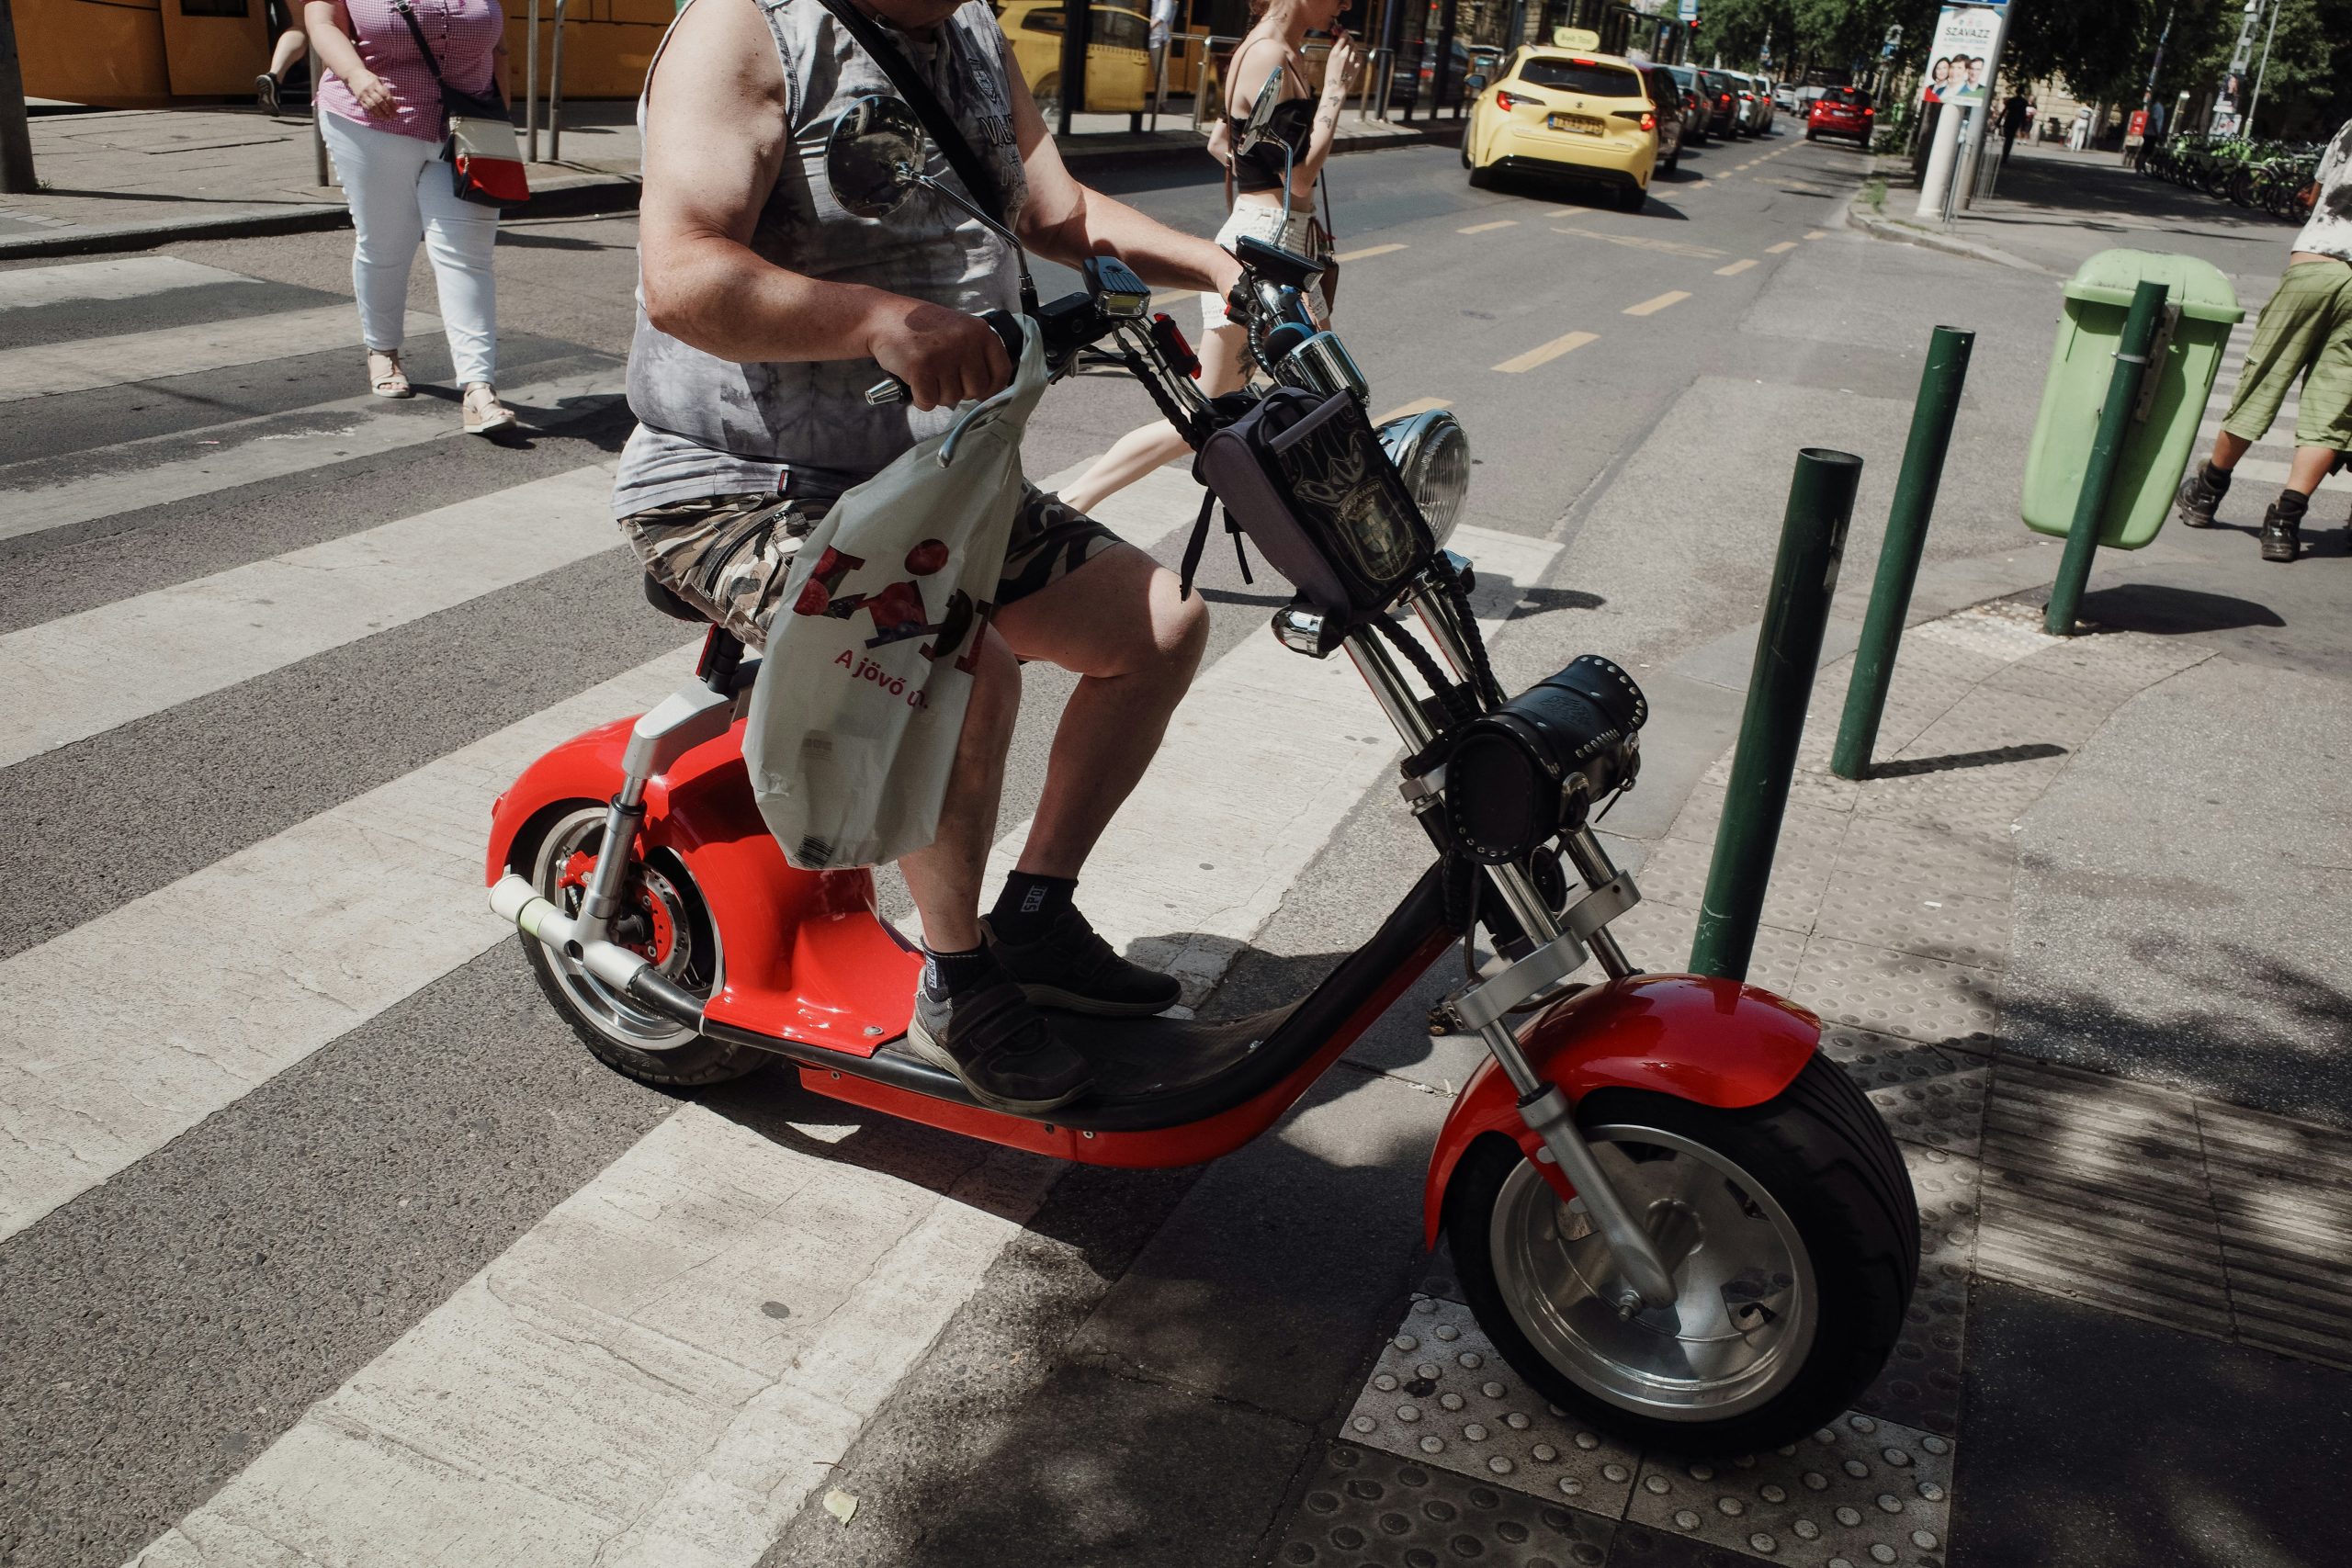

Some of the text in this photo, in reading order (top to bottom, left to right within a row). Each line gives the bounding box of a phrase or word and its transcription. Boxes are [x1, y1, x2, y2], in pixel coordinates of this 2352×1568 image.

[1945, 27, 1990, 39] SZAVAZZ
[833, 649, 854, 670] A
[850, 656, 908, 696] jövő
